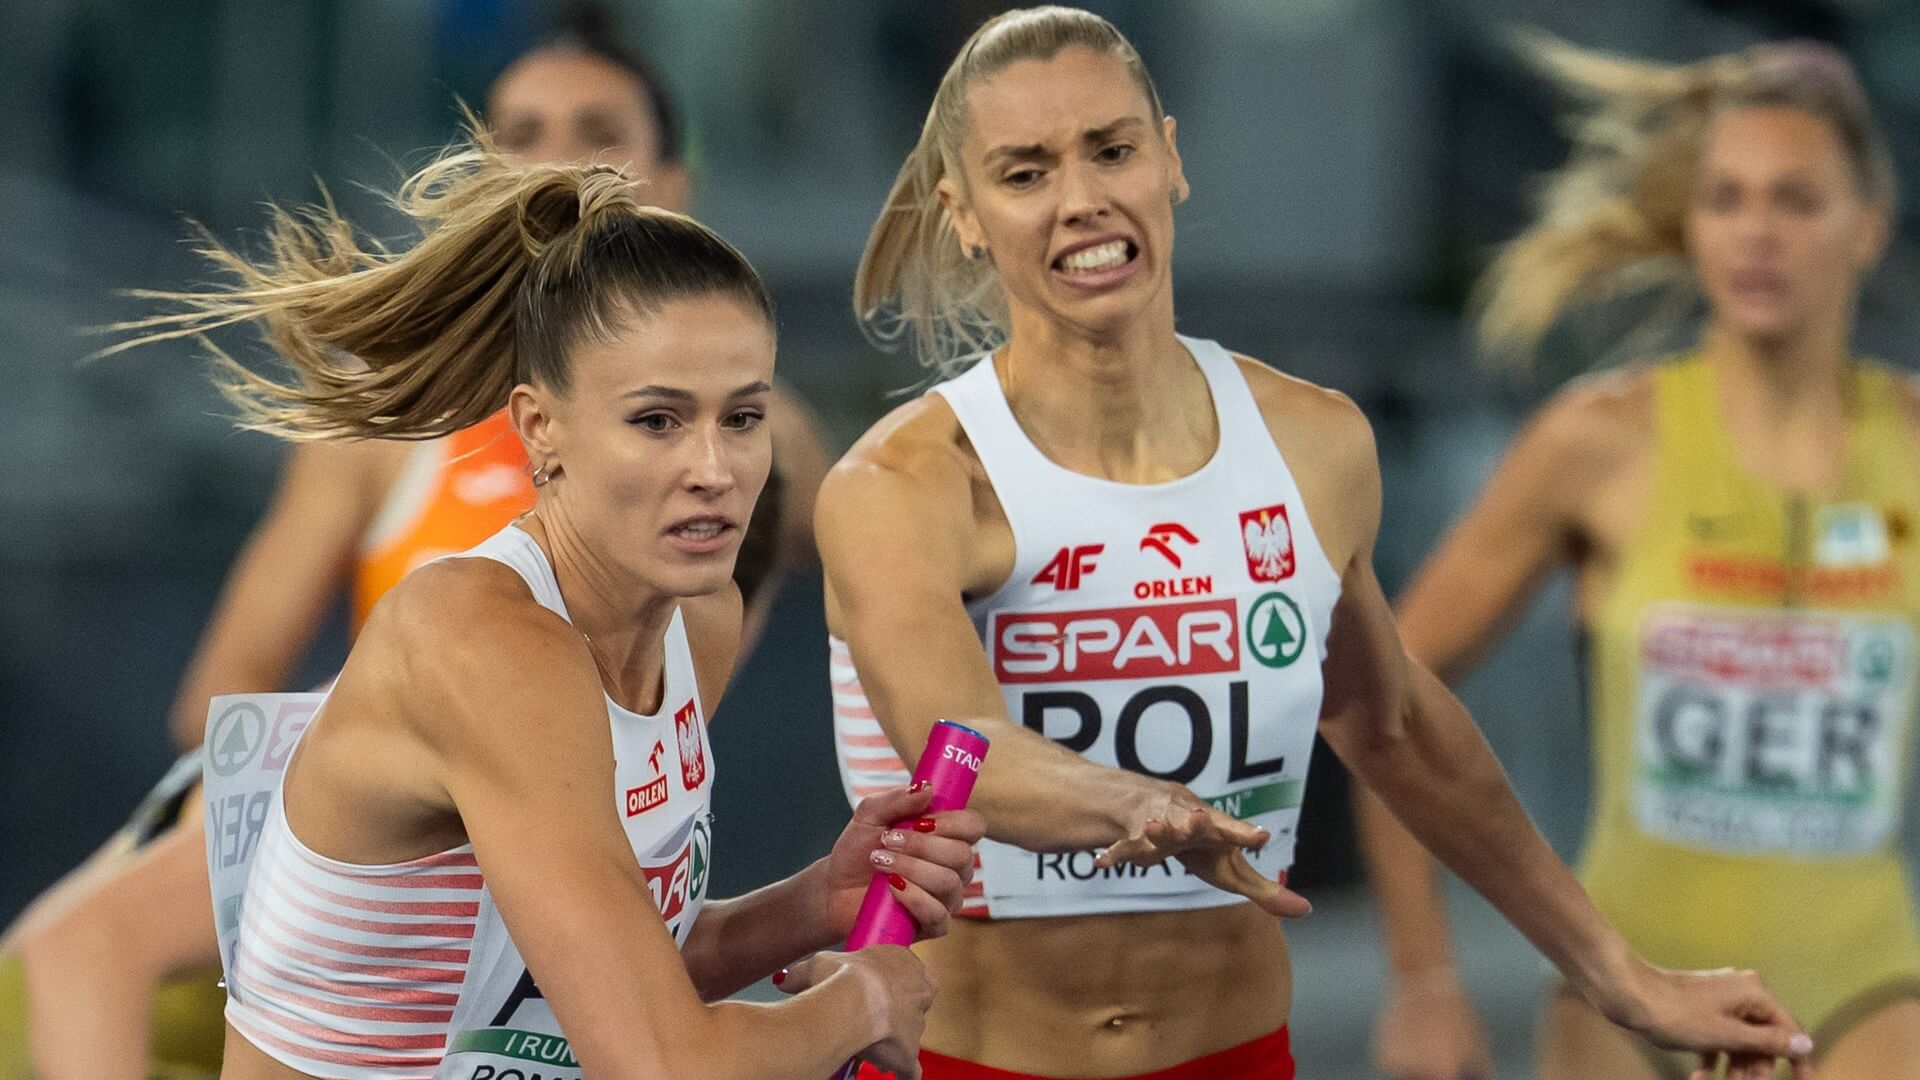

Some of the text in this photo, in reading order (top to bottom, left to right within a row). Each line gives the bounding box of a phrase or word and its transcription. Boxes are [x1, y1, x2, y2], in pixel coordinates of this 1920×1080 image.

[1134, 575, 1213, 601] ORLEN
[1001, 609, 1238, 674] SPAR
[1022, 680, 1285, 786] POL
[1653, 688, 1880, 794] GER
[628, 778, 668, 814] ORLEN
[504, 1032, 518, 1053] I
